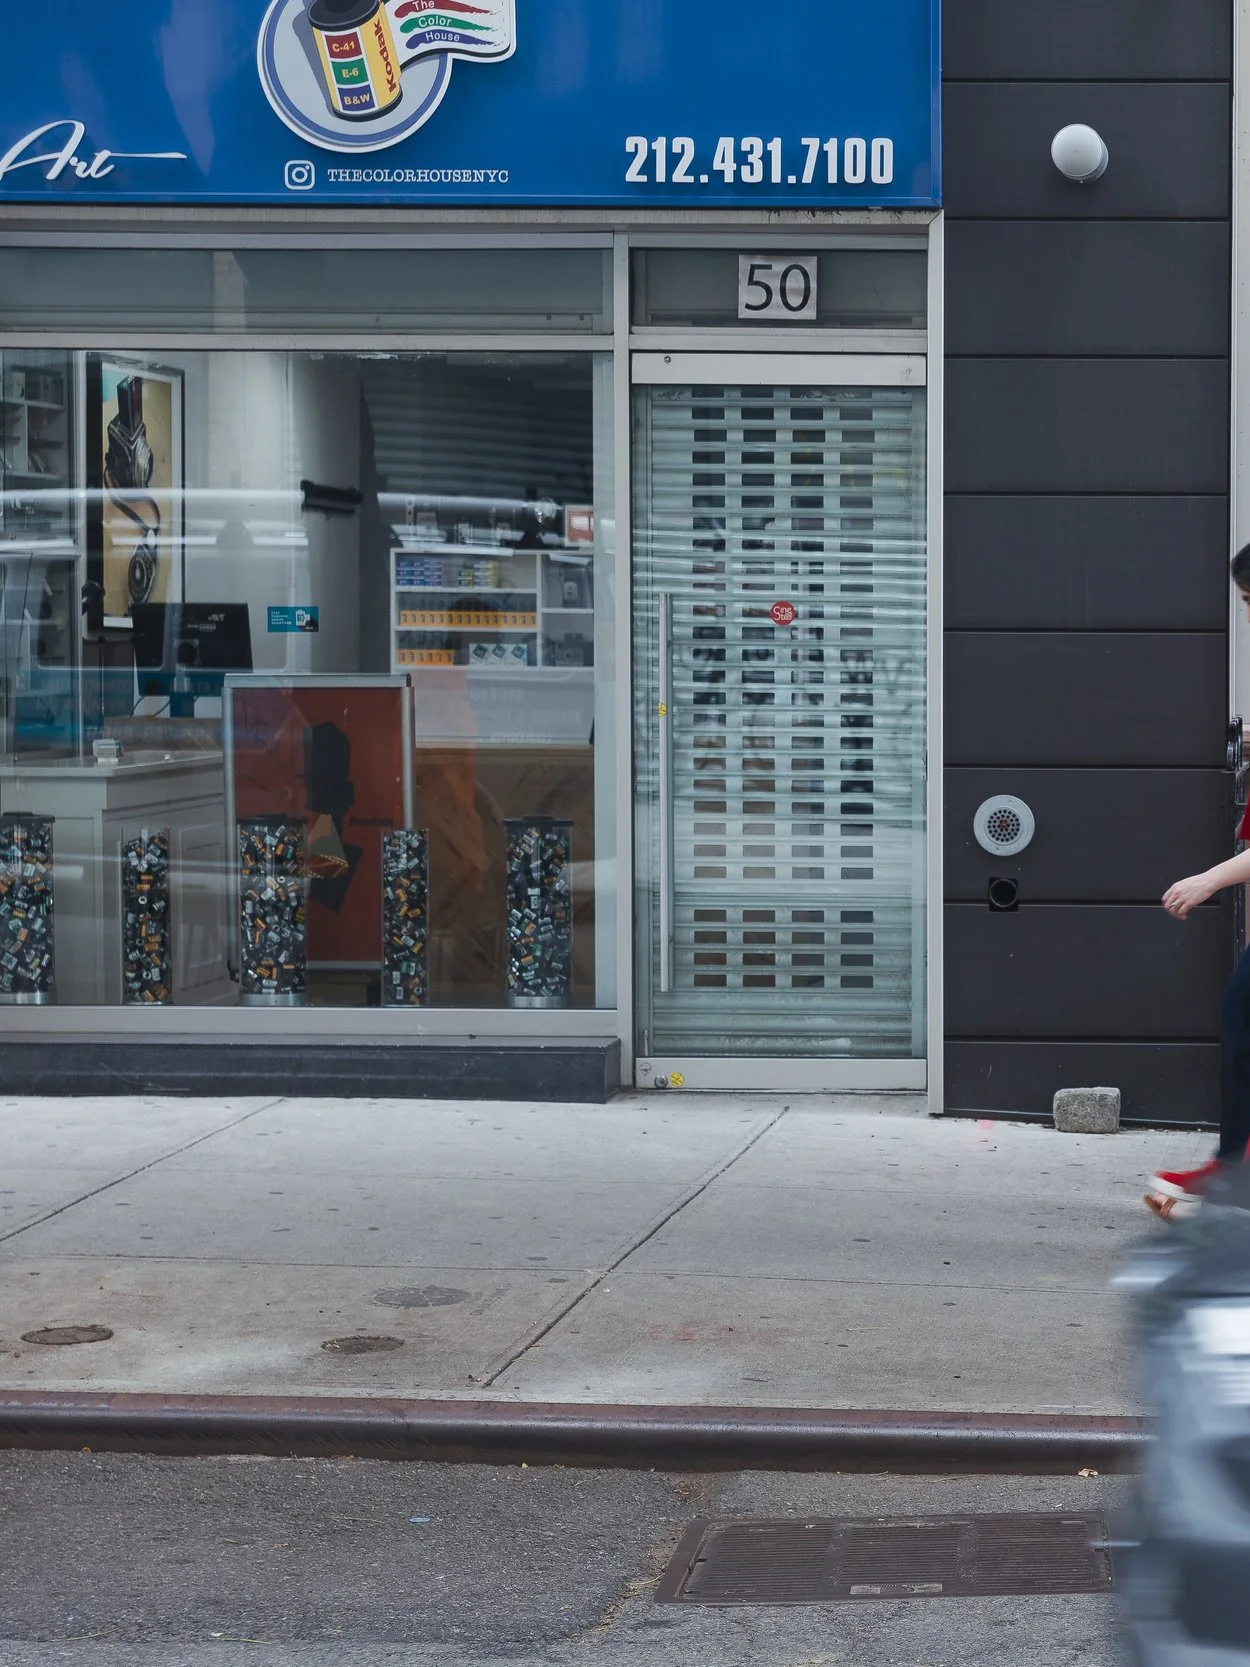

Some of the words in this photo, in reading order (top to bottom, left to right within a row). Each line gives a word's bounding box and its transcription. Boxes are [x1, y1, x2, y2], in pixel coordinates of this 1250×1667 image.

[412, 0, 435, 10] The
[418, 15, 451, 28] Color
[425, 31, 460, 42] House
[332, 40, 355, 52] C-41
[341, 67, 359, 79] E-6
[0, 119, 187, 180] Art
[625, 136, 894, 184] 212.431.7100
[327, 168, 509, 183] THECOLORHOUSENYC
[744, 263, 812, 312] 50
